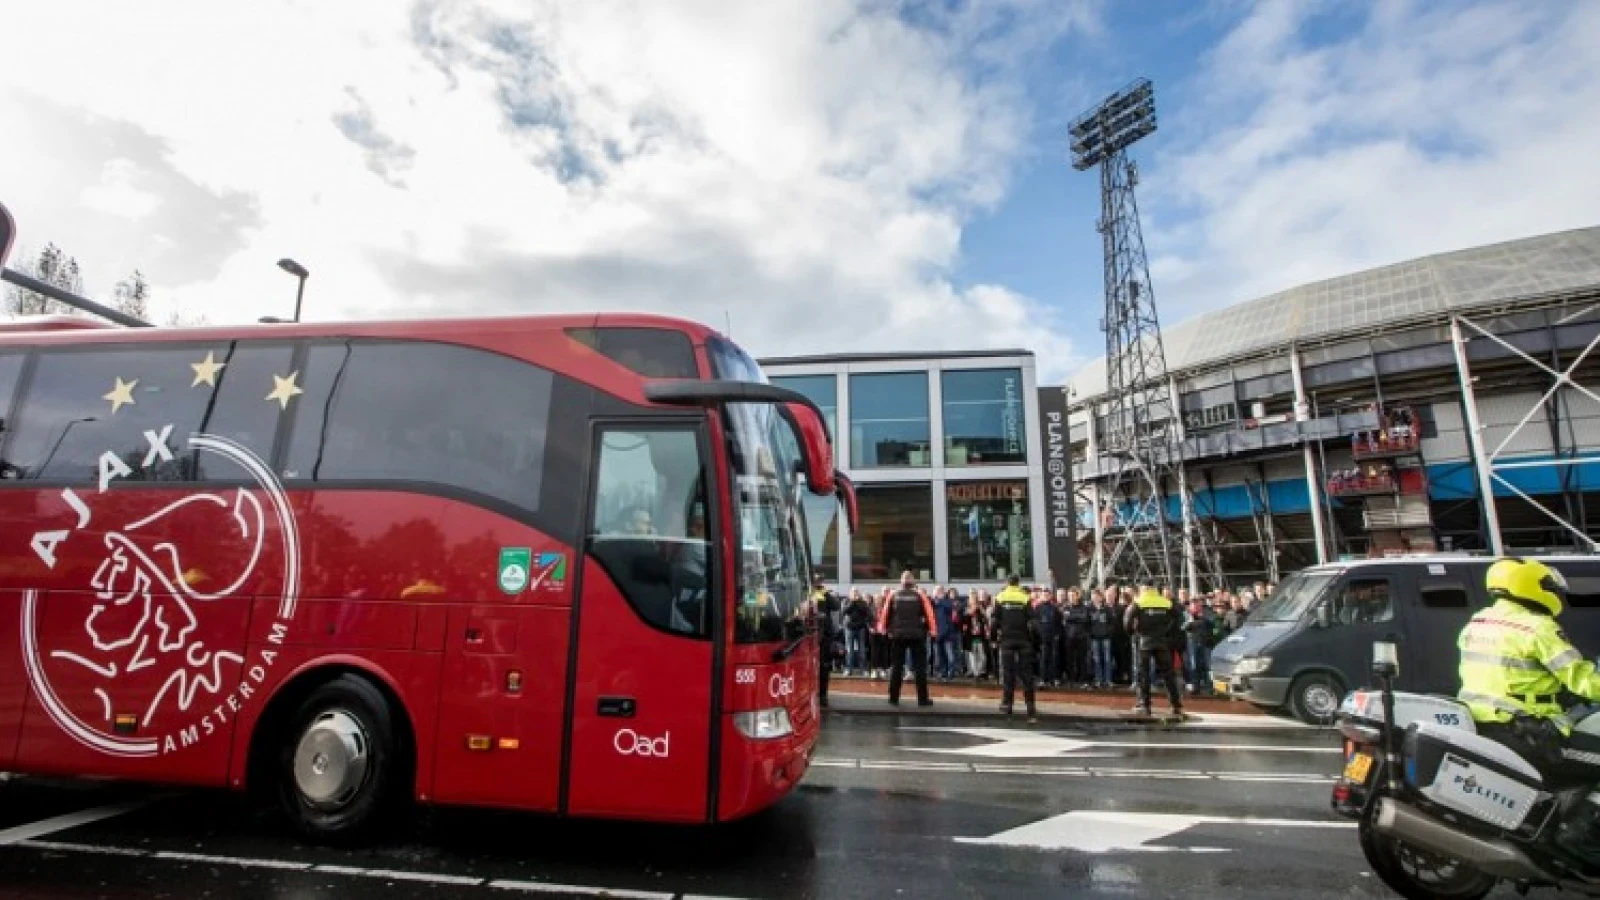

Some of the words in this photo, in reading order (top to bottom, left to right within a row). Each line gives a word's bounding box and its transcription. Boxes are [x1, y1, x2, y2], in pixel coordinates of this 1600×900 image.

[31, 424, 174, 569] AJAX
[1046, 411, 1069, 537] PLAN@OFFICE
[163, 624, 289, 755] AMSTERDAM
[769, 669, 794, 697] Oad
[1434, 713, 1459, 725] 195
[614, 728, 670, 757] Oad
